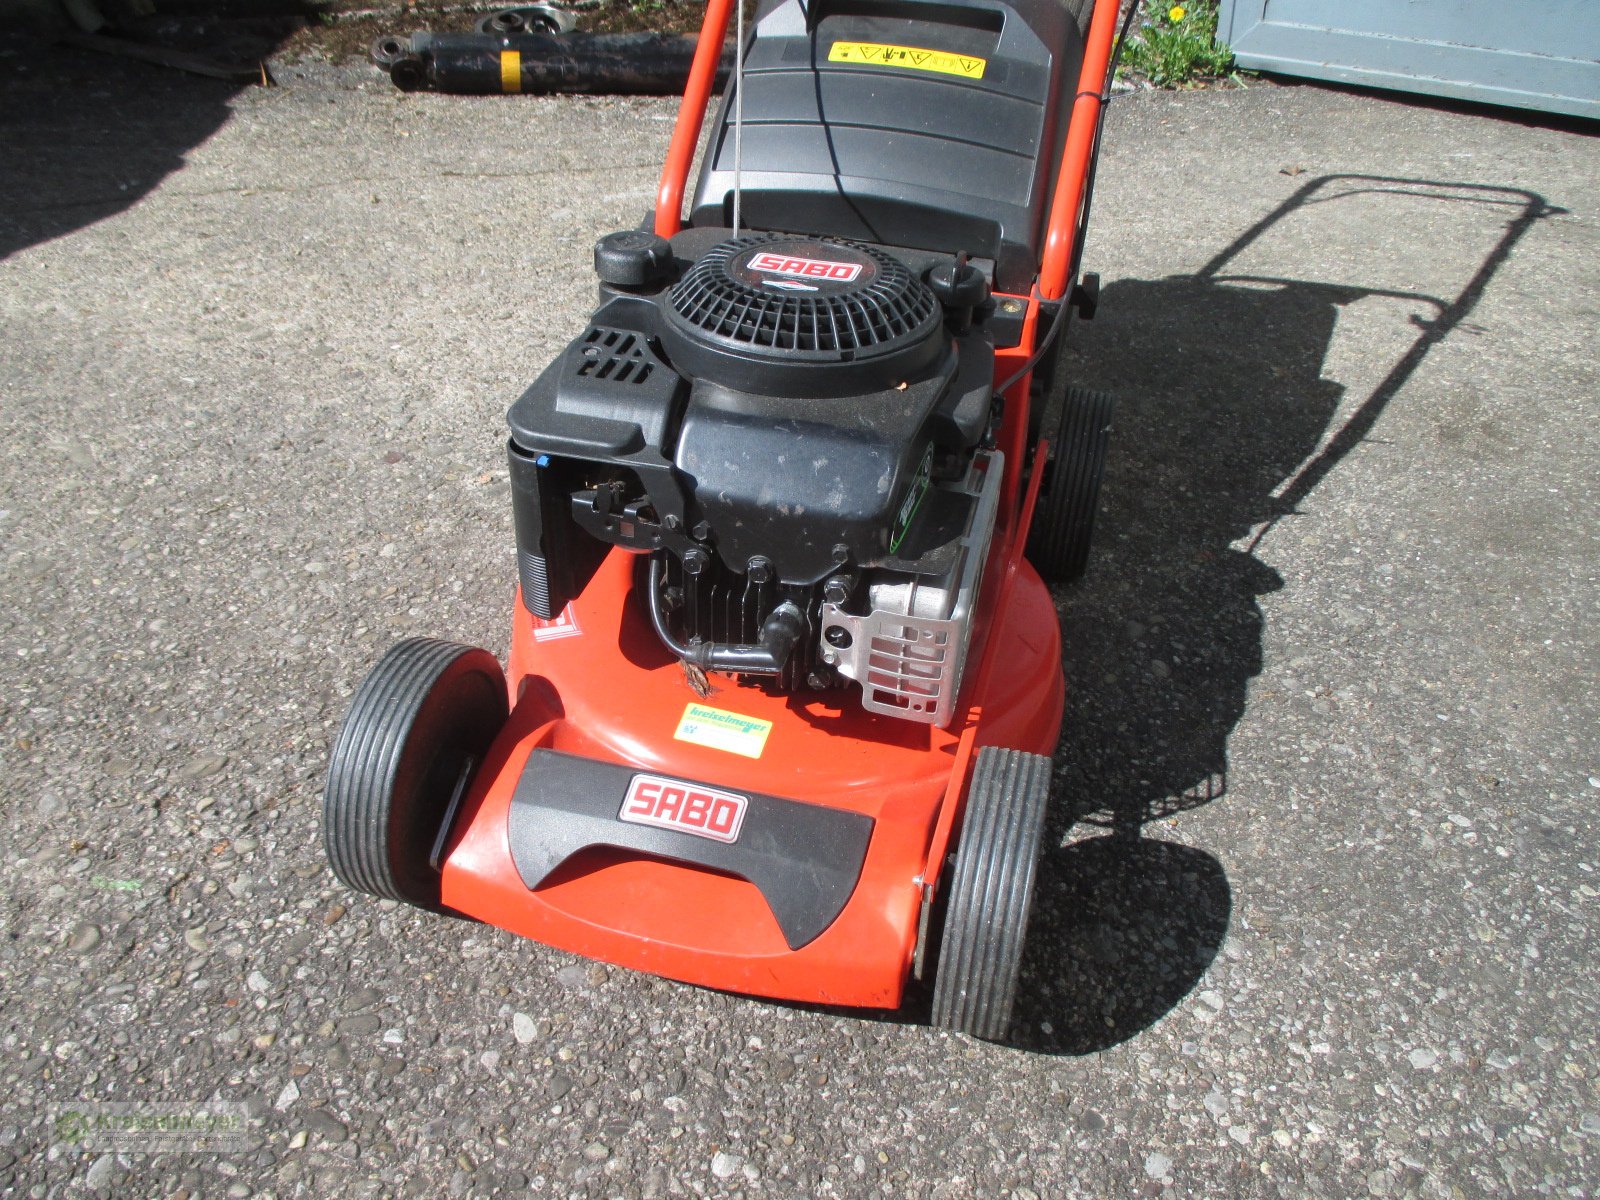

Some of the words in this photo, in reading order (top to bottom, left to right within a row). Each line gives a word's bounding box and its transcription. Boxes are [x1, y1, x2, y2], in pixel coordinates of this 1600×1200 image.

[755, 256, 855, 279] SABO
[689, 706, 767, 733] kreiselmeyer
[629, 782, 739, 834] SABO
